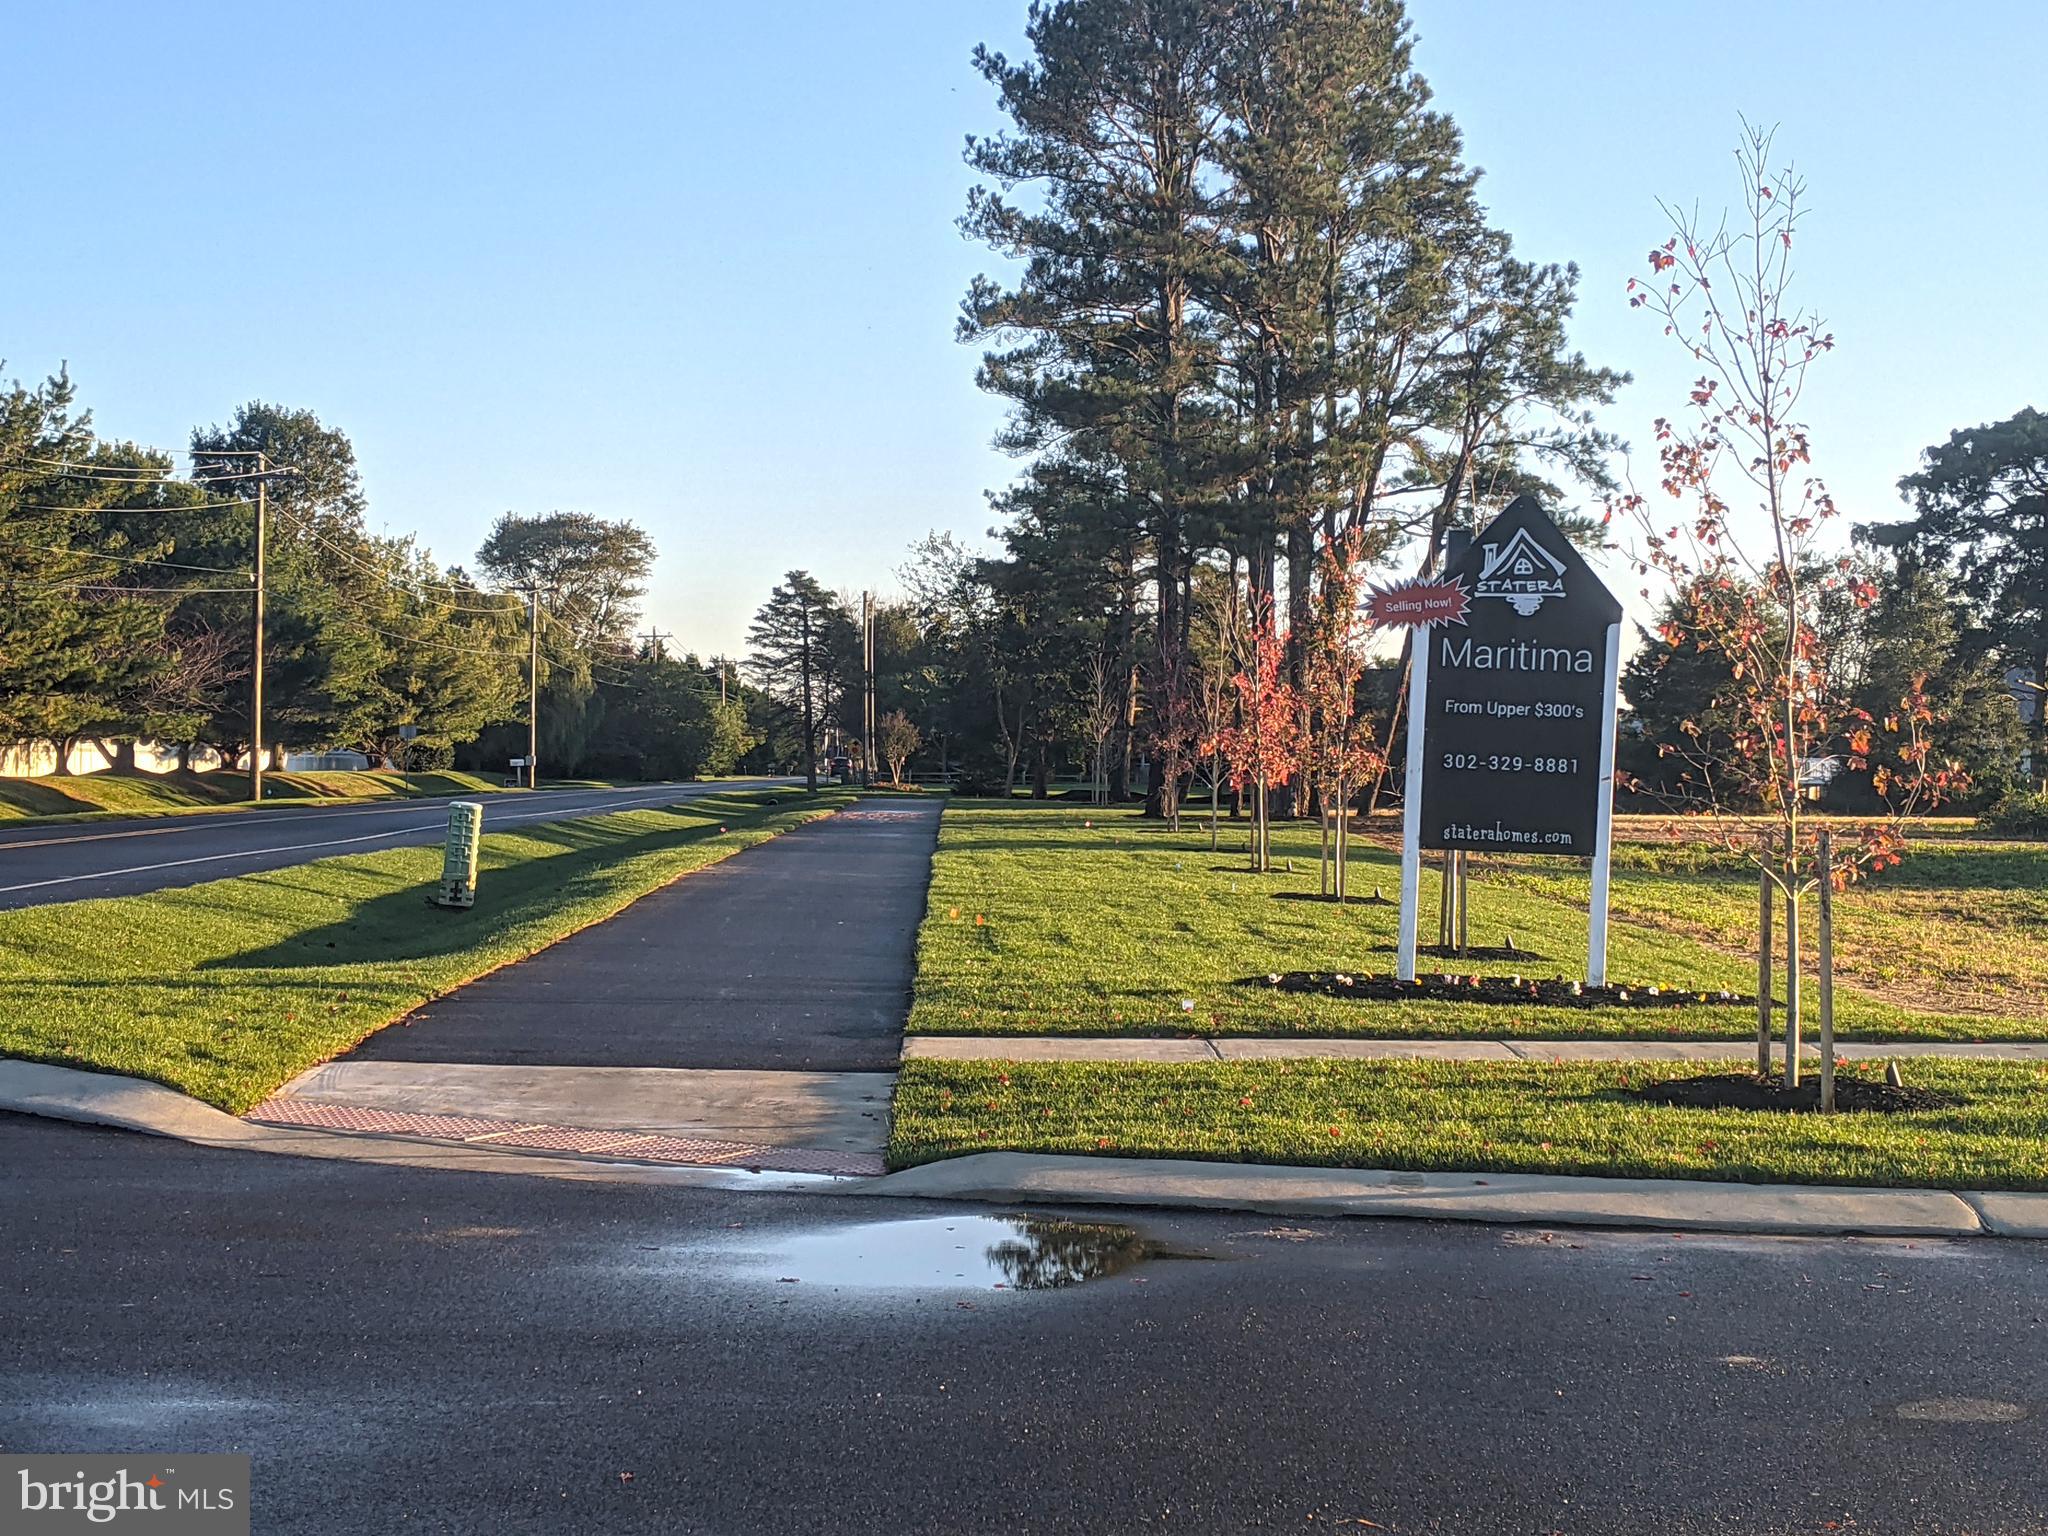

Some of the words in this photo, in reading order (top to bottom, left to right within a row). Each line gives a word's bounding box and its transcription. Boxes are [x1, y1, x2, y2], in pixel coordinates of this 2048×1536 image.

[1476, 579, 1564, 592] STATERA
[1385, 601, 1422, 613] Selling
[1425, 598, 1453, 609] Now!
[1442, 637, 1593, 673] Maritima
[1445, 700, 1482, 714] From
[1487, 701, 1531, 718] Upper
[1534, 701, 1584, 719] $300's
[1443, 754, 1578, 773] 302-329-8881
[1443, 821, 1572, 844] staterahomes.com
